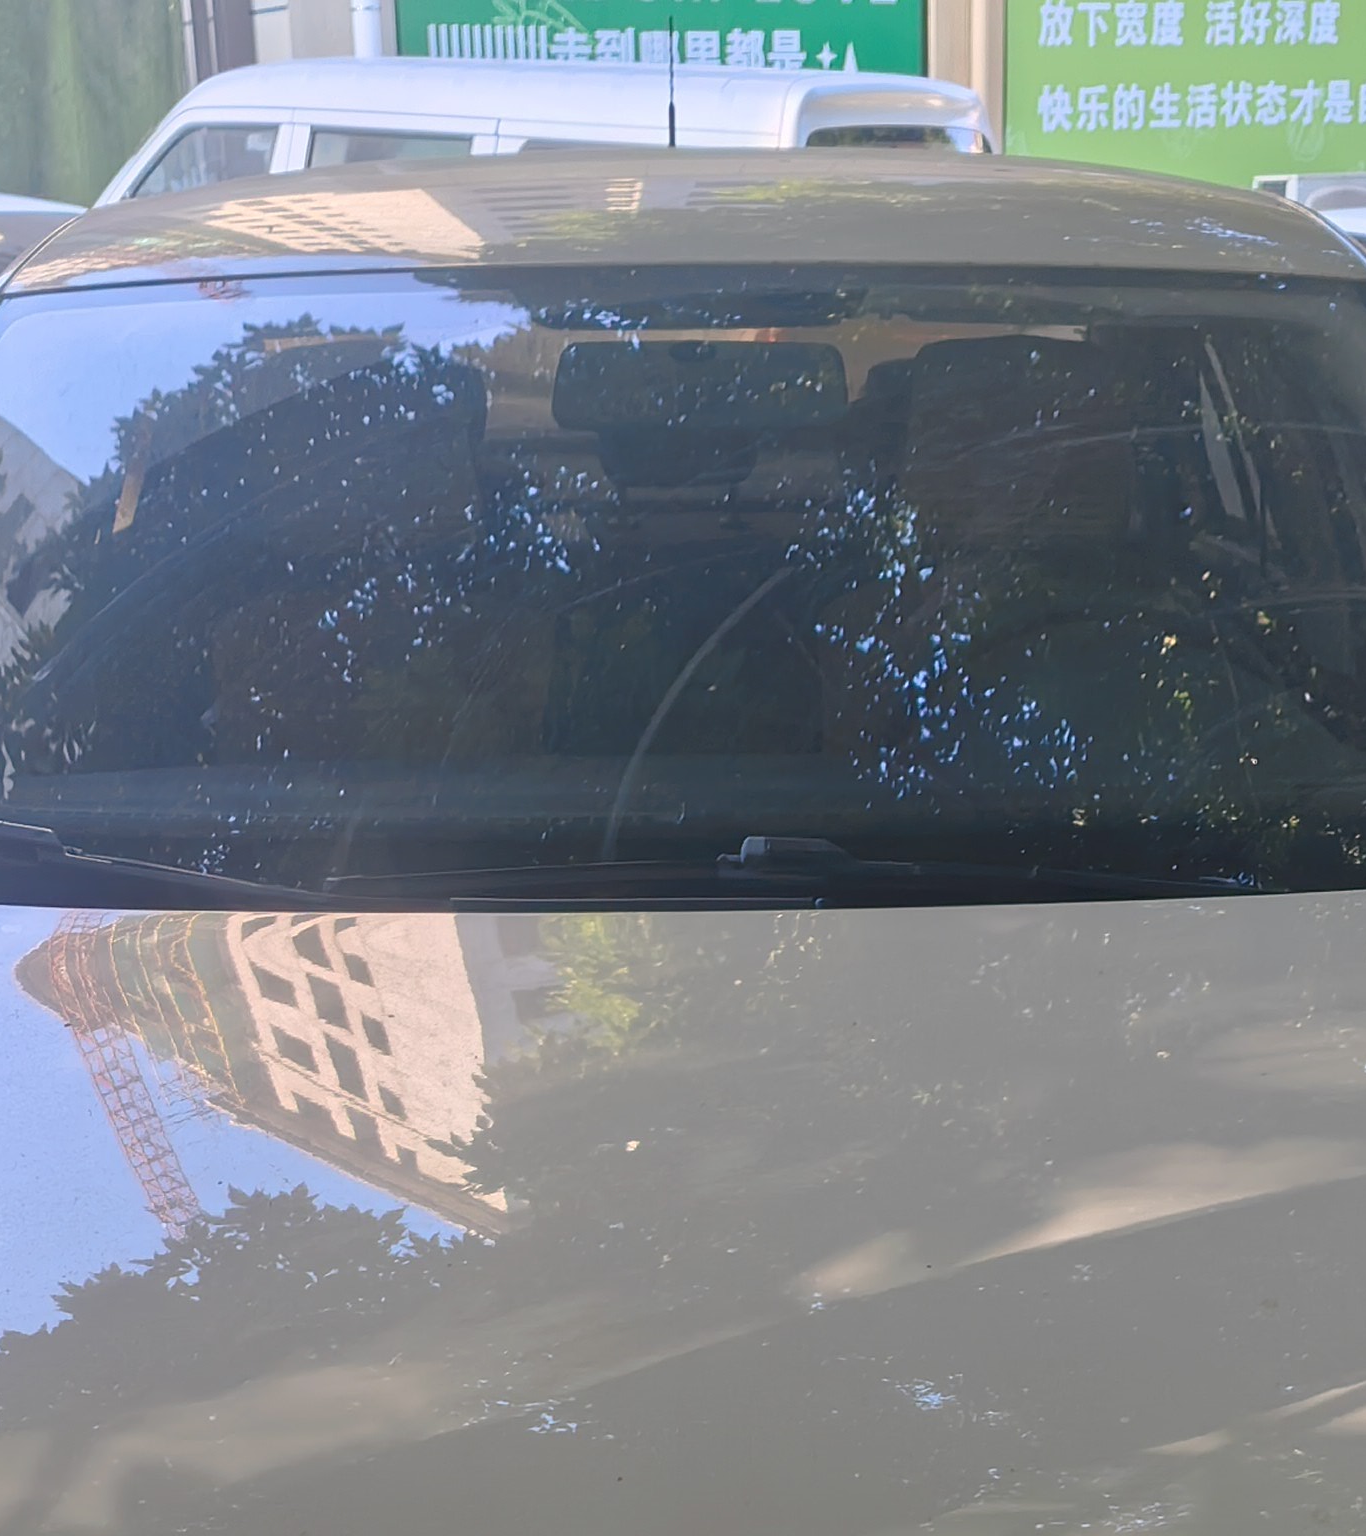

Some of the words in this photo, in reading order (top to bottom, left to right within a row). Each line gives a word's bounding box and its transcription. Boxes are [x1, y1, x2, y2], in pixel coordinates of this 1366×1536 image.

[1038, 0, 1185, 46] 放下宽度
[1205, 0, 1340, 45] 活好深度
